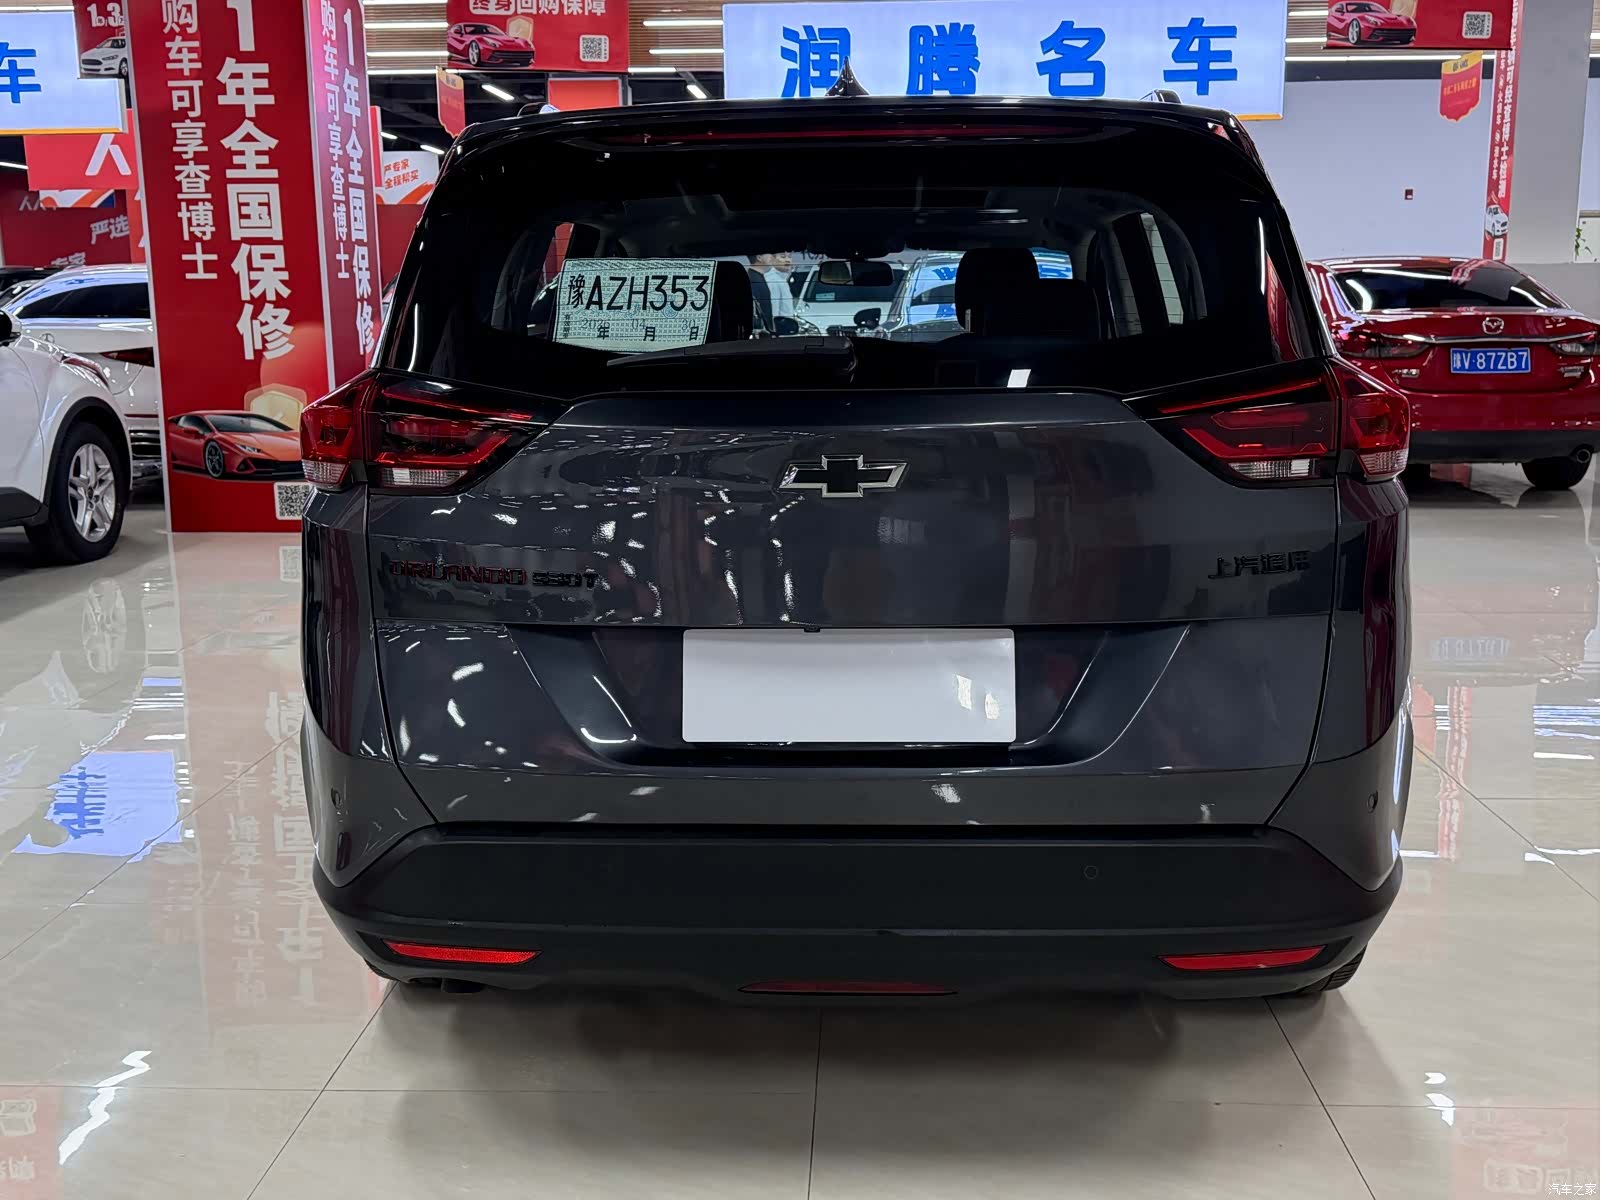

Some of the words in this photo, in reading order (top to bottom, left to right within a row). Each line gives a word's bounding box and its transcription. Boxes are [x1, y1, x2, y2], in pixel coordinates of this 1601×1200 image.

[160, 0, 219, 280] 购车可享查博士
[216, 0, 296, 361] 1年全国保修
[320, 0, 350, 279] 购车可享查博士
[342, 8, 375, 355] 1年全国保修
[780, 17, 1238, 98] 润腾名车
[566, 273, 710, 312] 豫AZH353
[597, 326, 610, 340] 年
[643, 326, 656, 342] 月
[688, 326, 700, 341] 日
